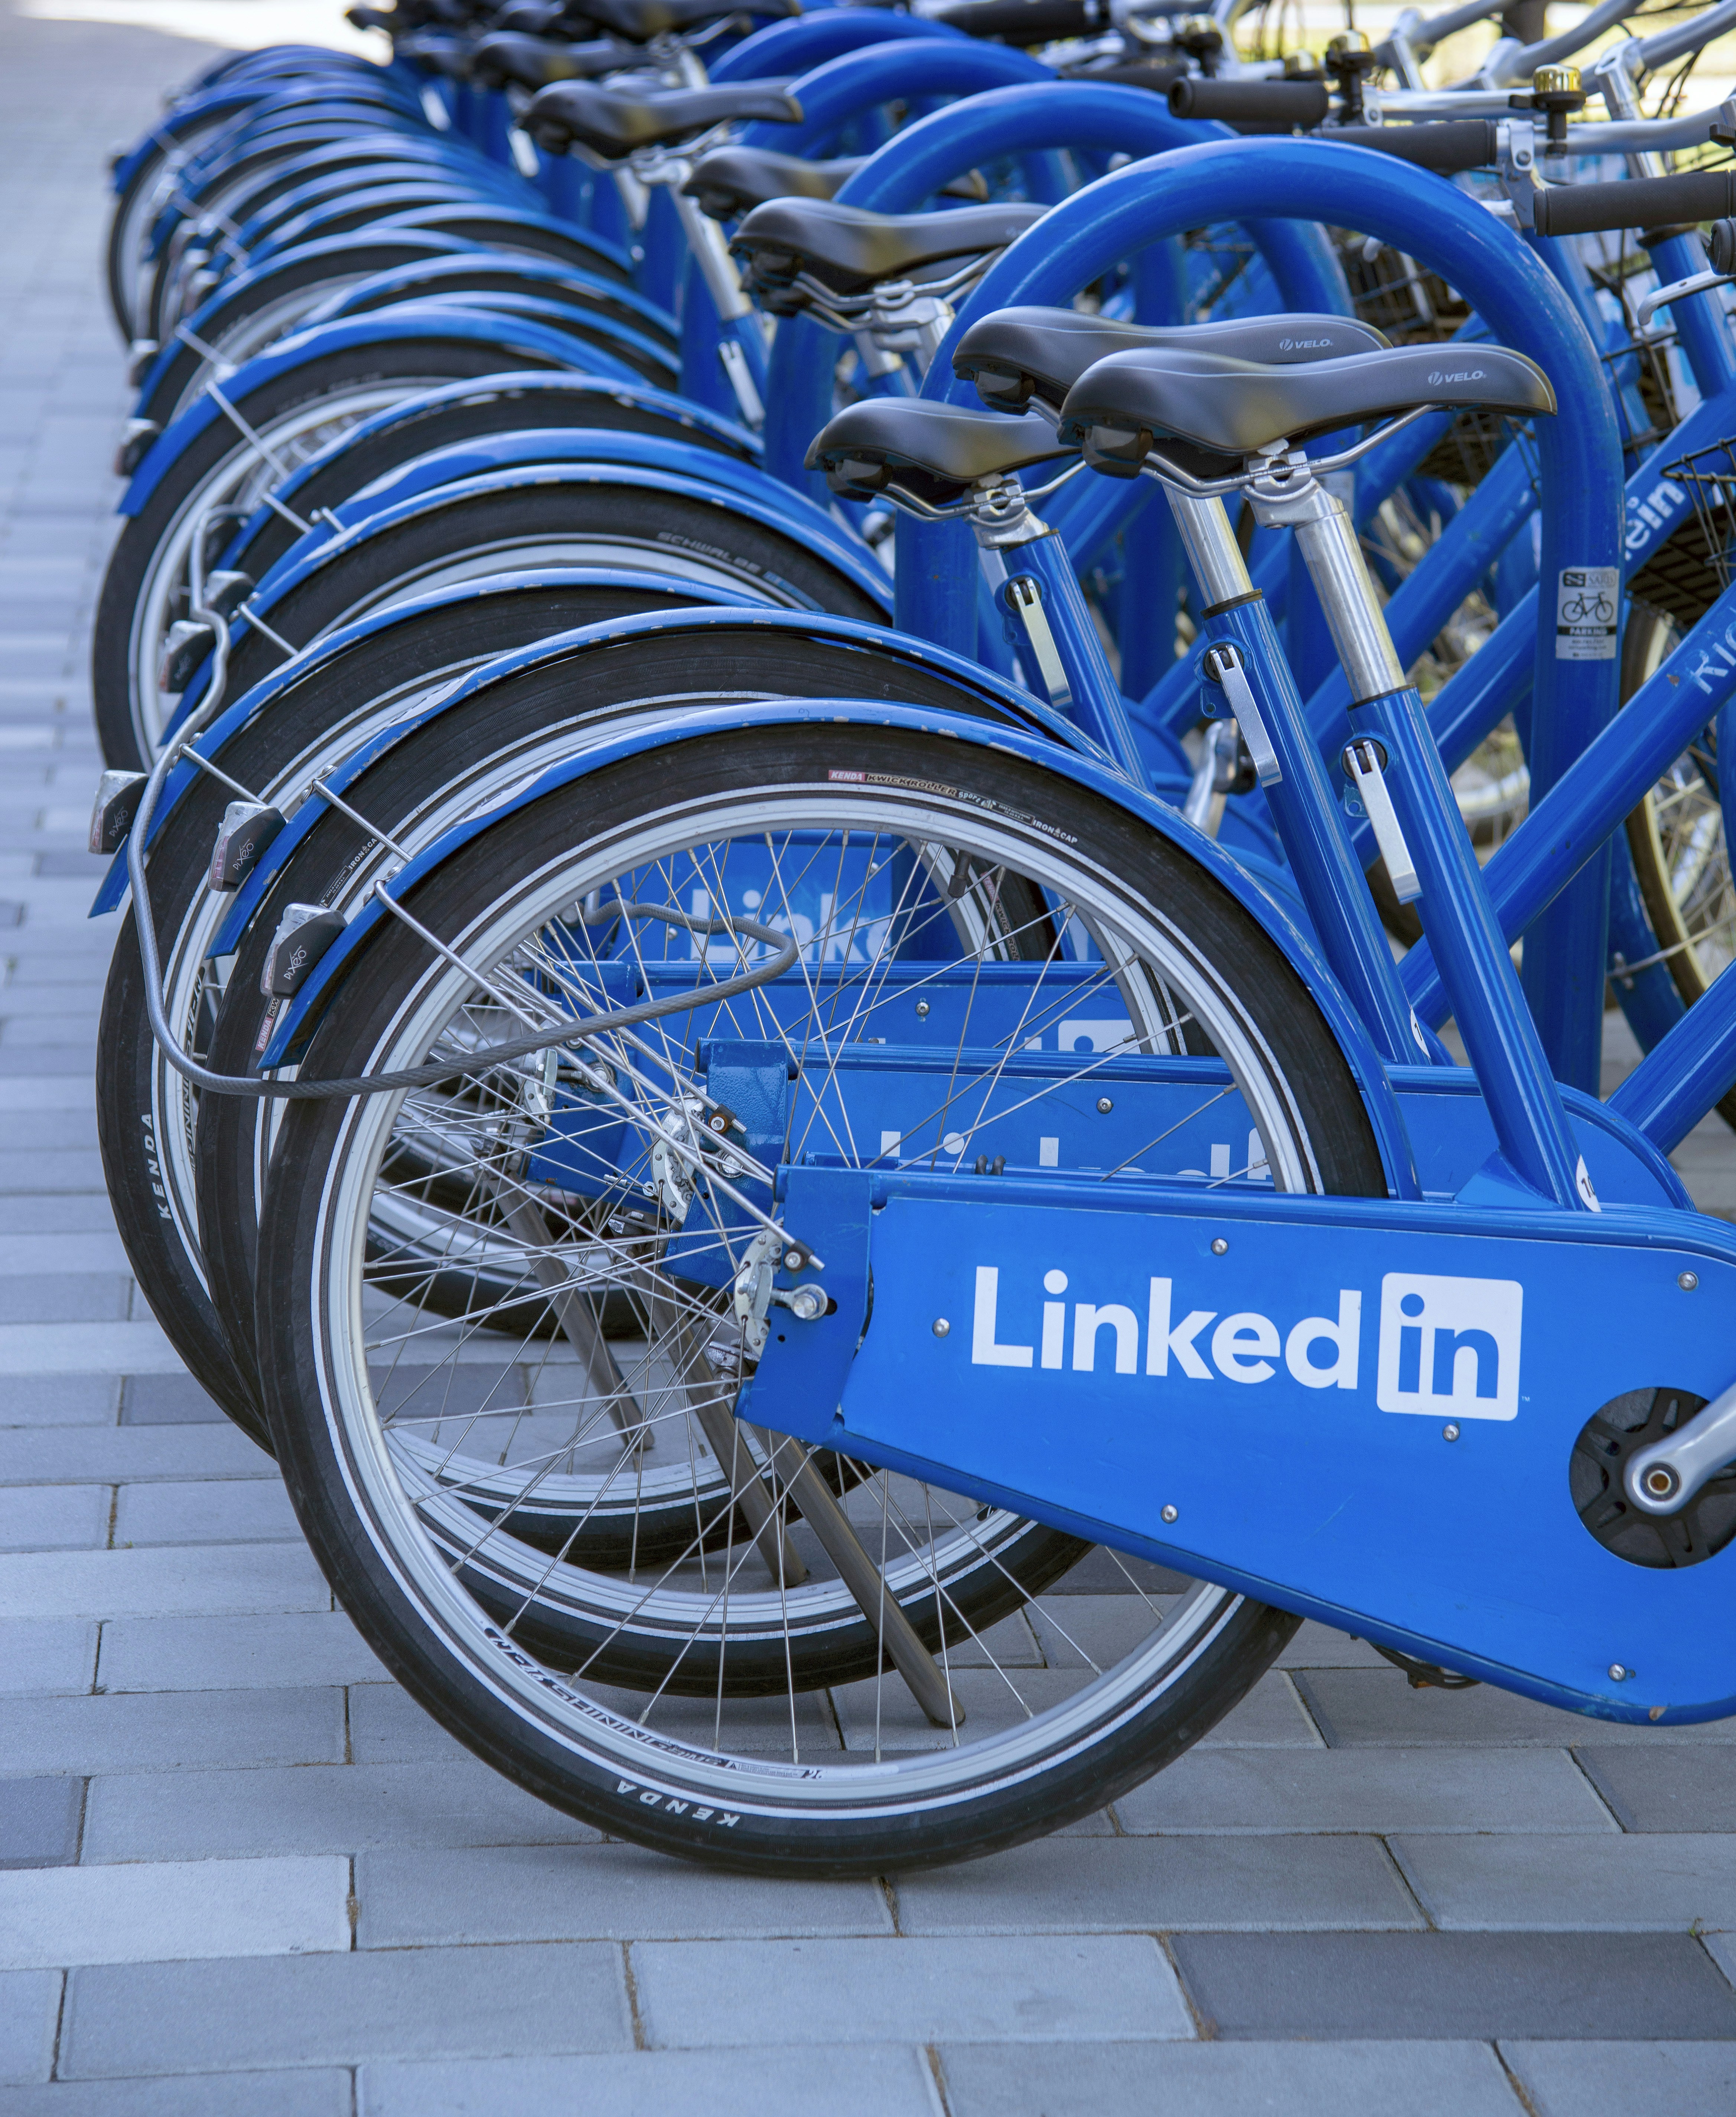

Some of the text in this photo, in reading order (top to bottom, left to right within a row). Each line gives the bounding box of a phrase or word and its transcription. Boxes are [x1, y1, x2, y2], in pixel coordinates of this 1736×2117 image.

[1295, 338, 1331, 349] VELO
[1445, 370, 1483, 383] VELO
[831, 771, 863, 781] KENDA
[1032, 819, 1078, 843] IRON CAP
[348, 851, 365, 870] IRON
[257, 1019, 272, 1050] KENDA
[141, 1113, 172, 1220] KENDA
[551, 1684, 671, 1749] SHINING
[616, 1779, 740, 1828] KENDA
